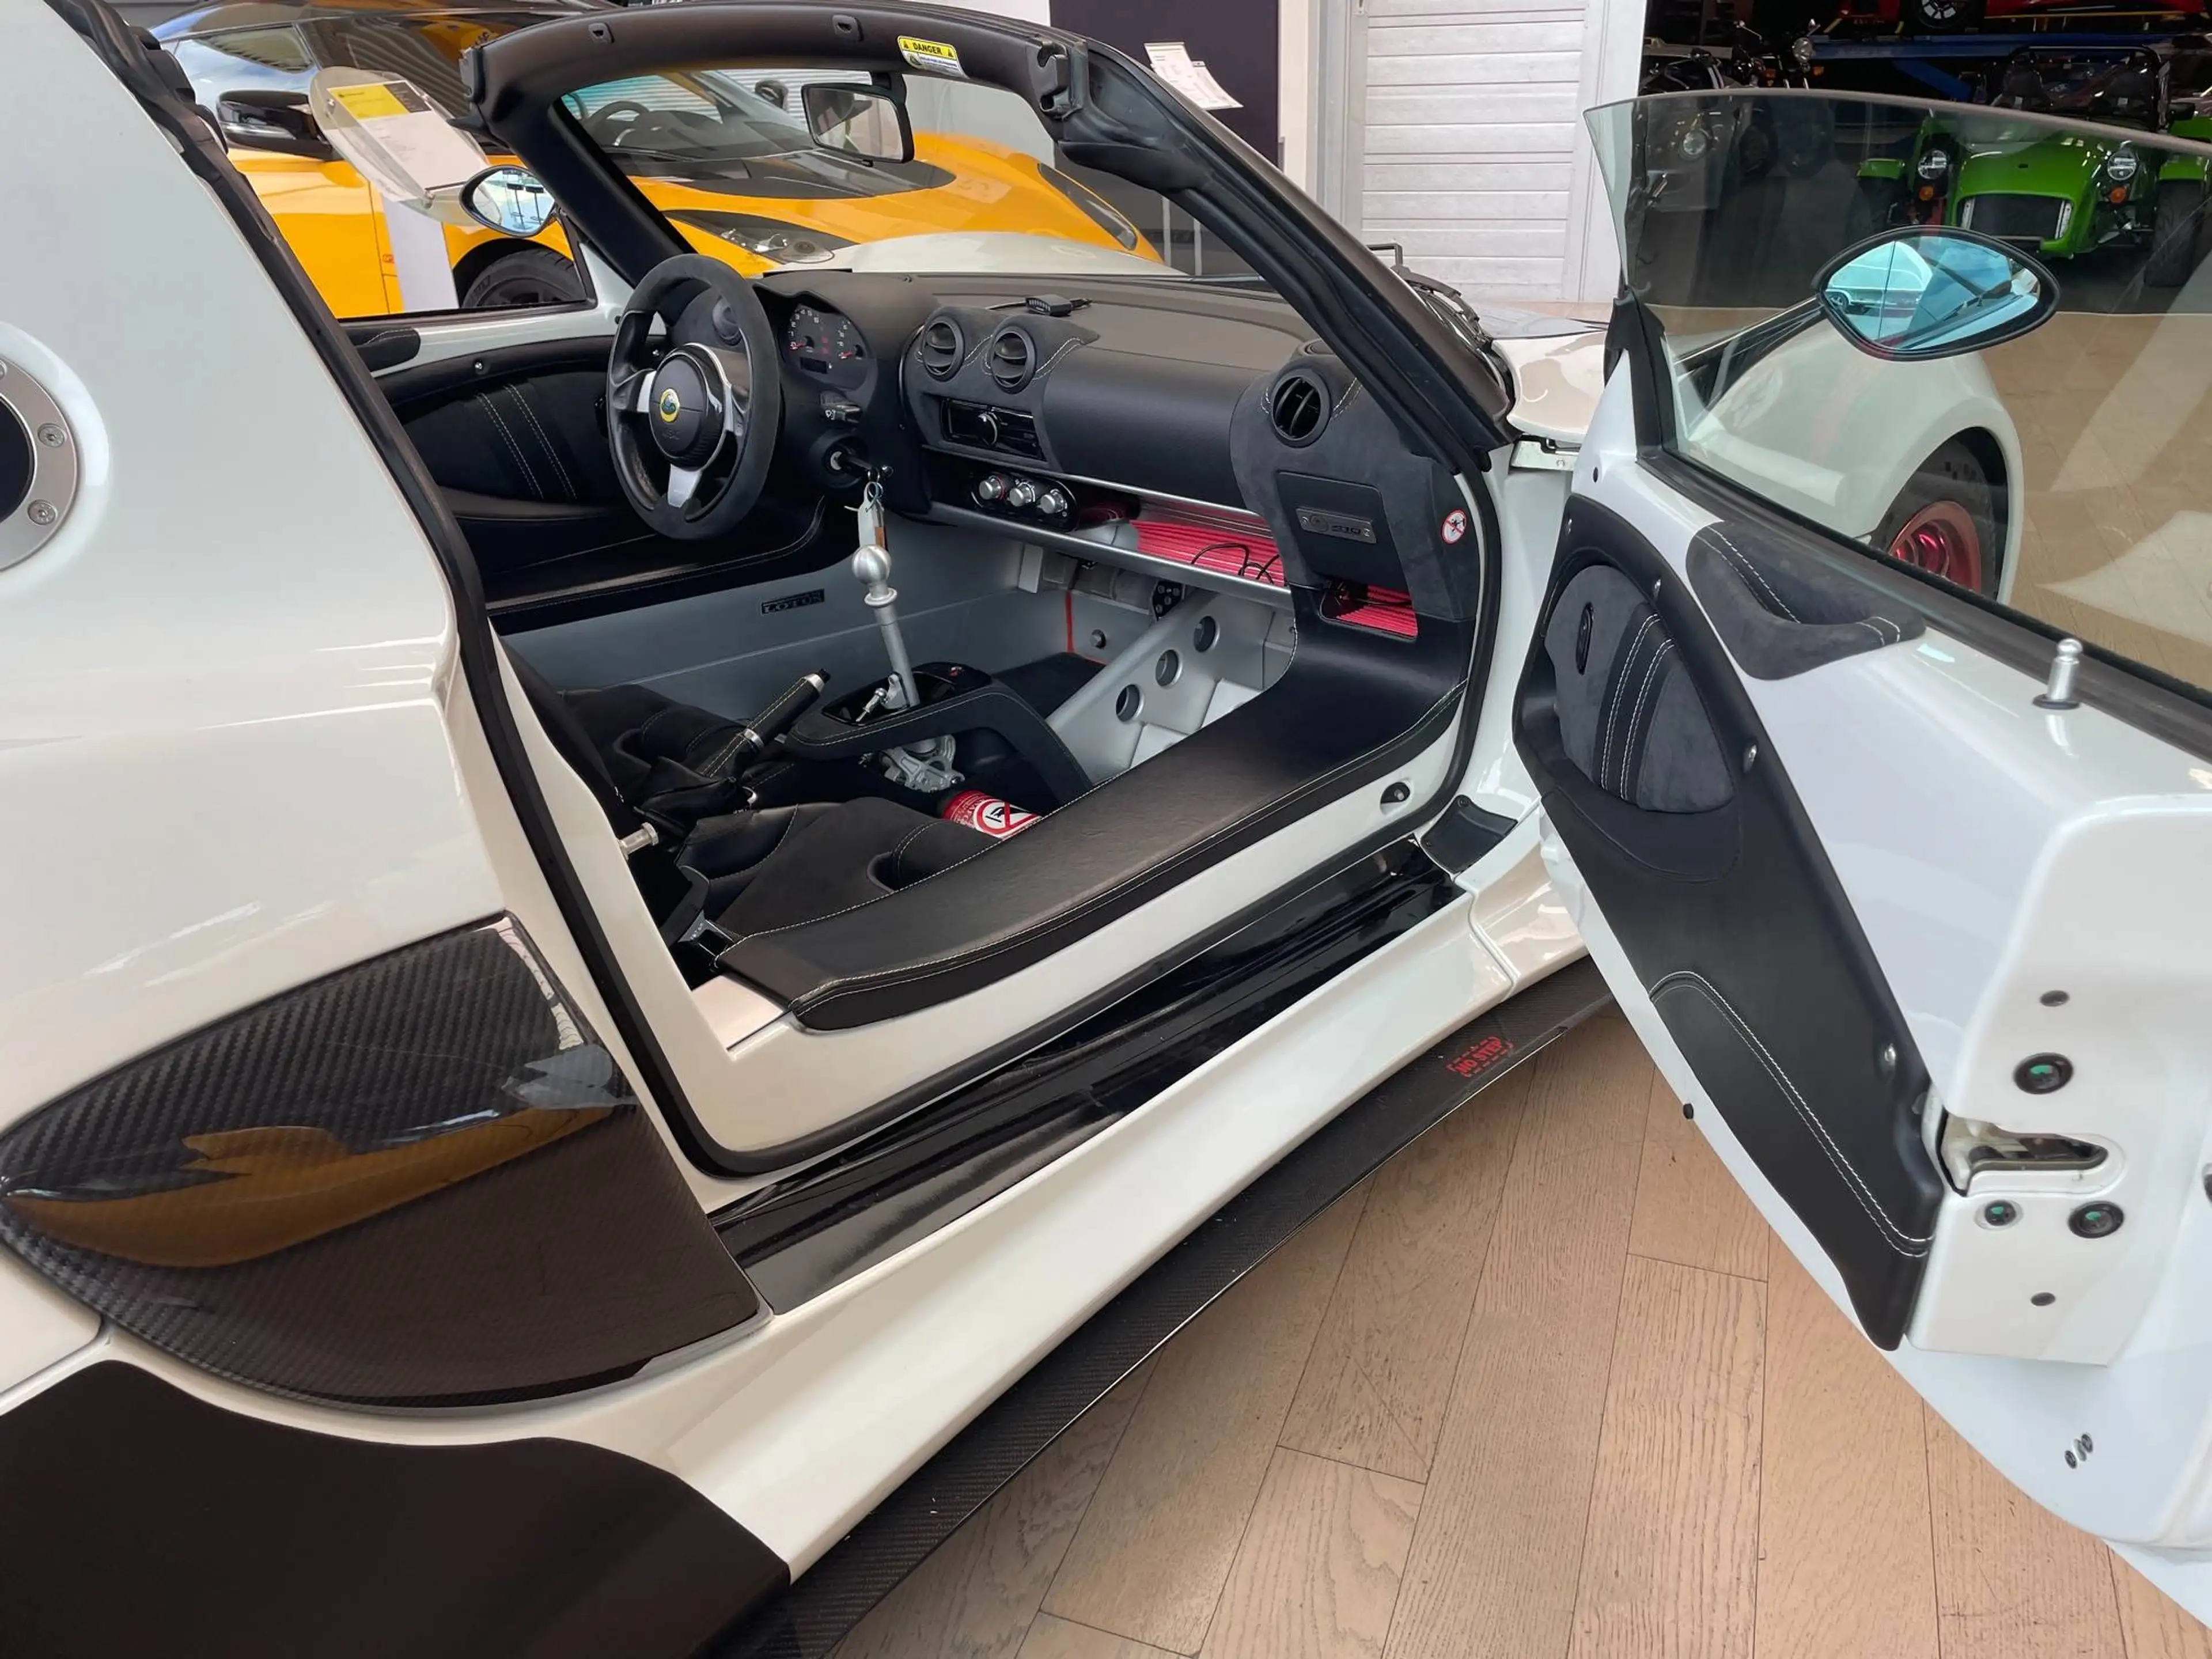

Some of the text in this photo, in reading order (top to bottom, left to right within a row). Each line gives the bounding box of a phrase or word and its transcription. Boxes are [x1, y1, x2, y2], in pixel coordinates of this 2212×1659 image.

[913, 43, 942, 55] DANGER
[1455, 1040, 1502, 1074] NO STEP
